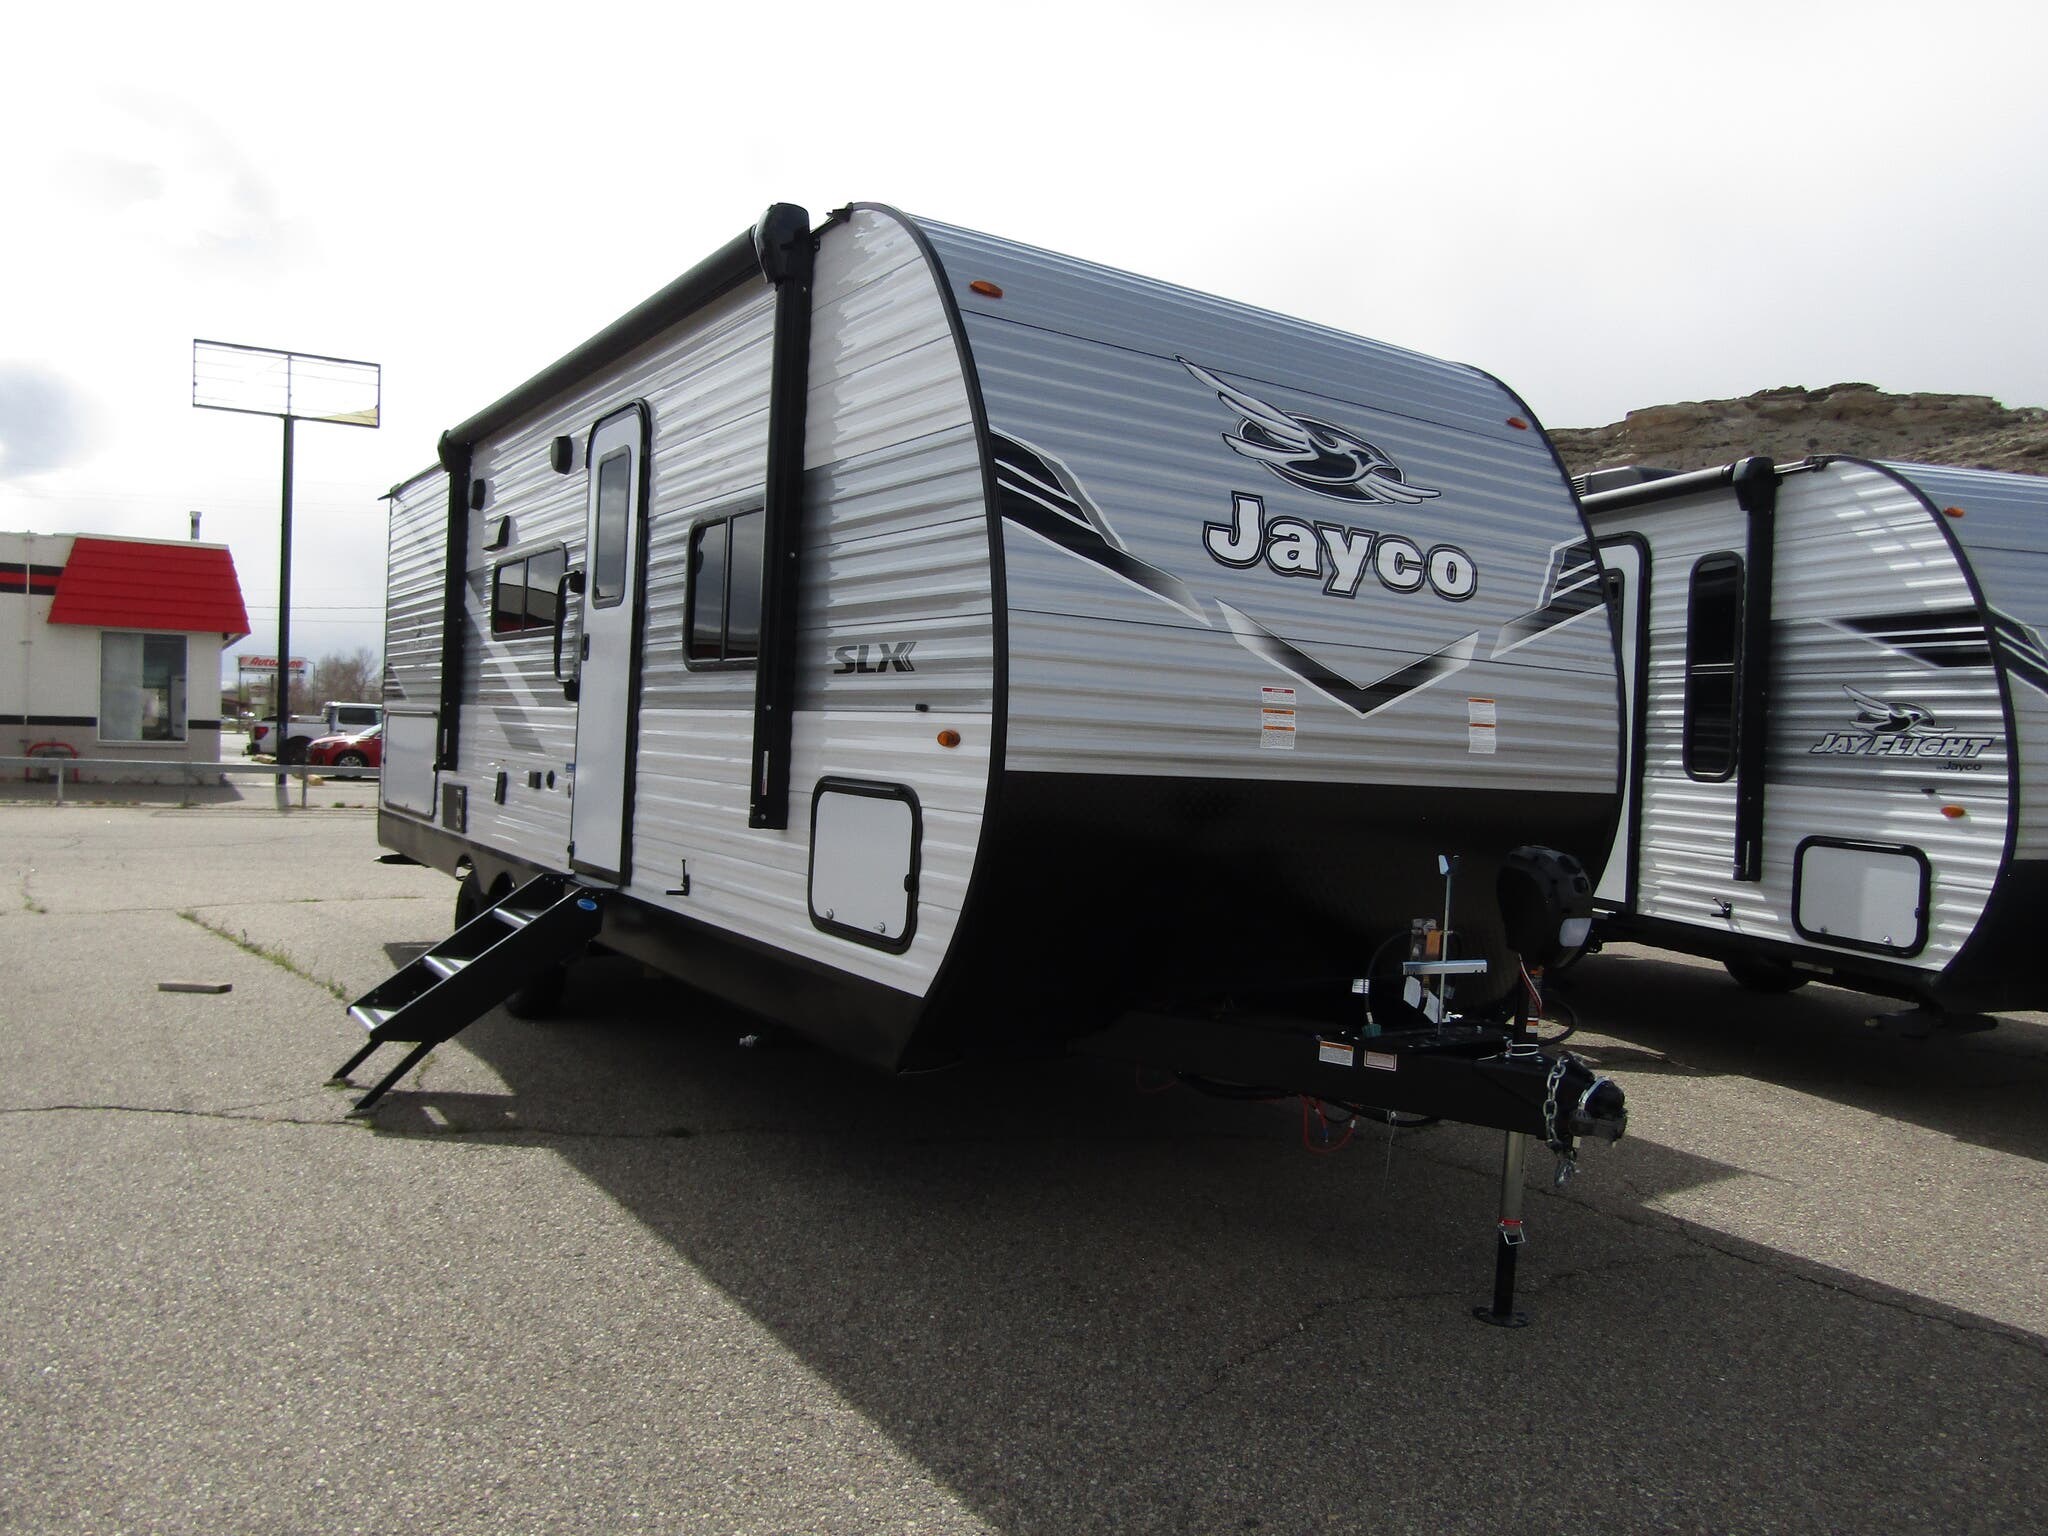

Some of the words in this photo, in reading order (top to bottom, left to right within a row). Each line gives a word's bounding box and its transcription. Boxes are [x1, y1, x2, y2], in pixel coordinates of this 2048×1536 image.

[1202, 490, 1478, 602] Jayco
[251, 656, 303, 668] Autone
[833, 642, 917, 674] SLX
[1810, 733, 1872, 755] JAY
[1866, 735, 1995, 758] FLIGHT
